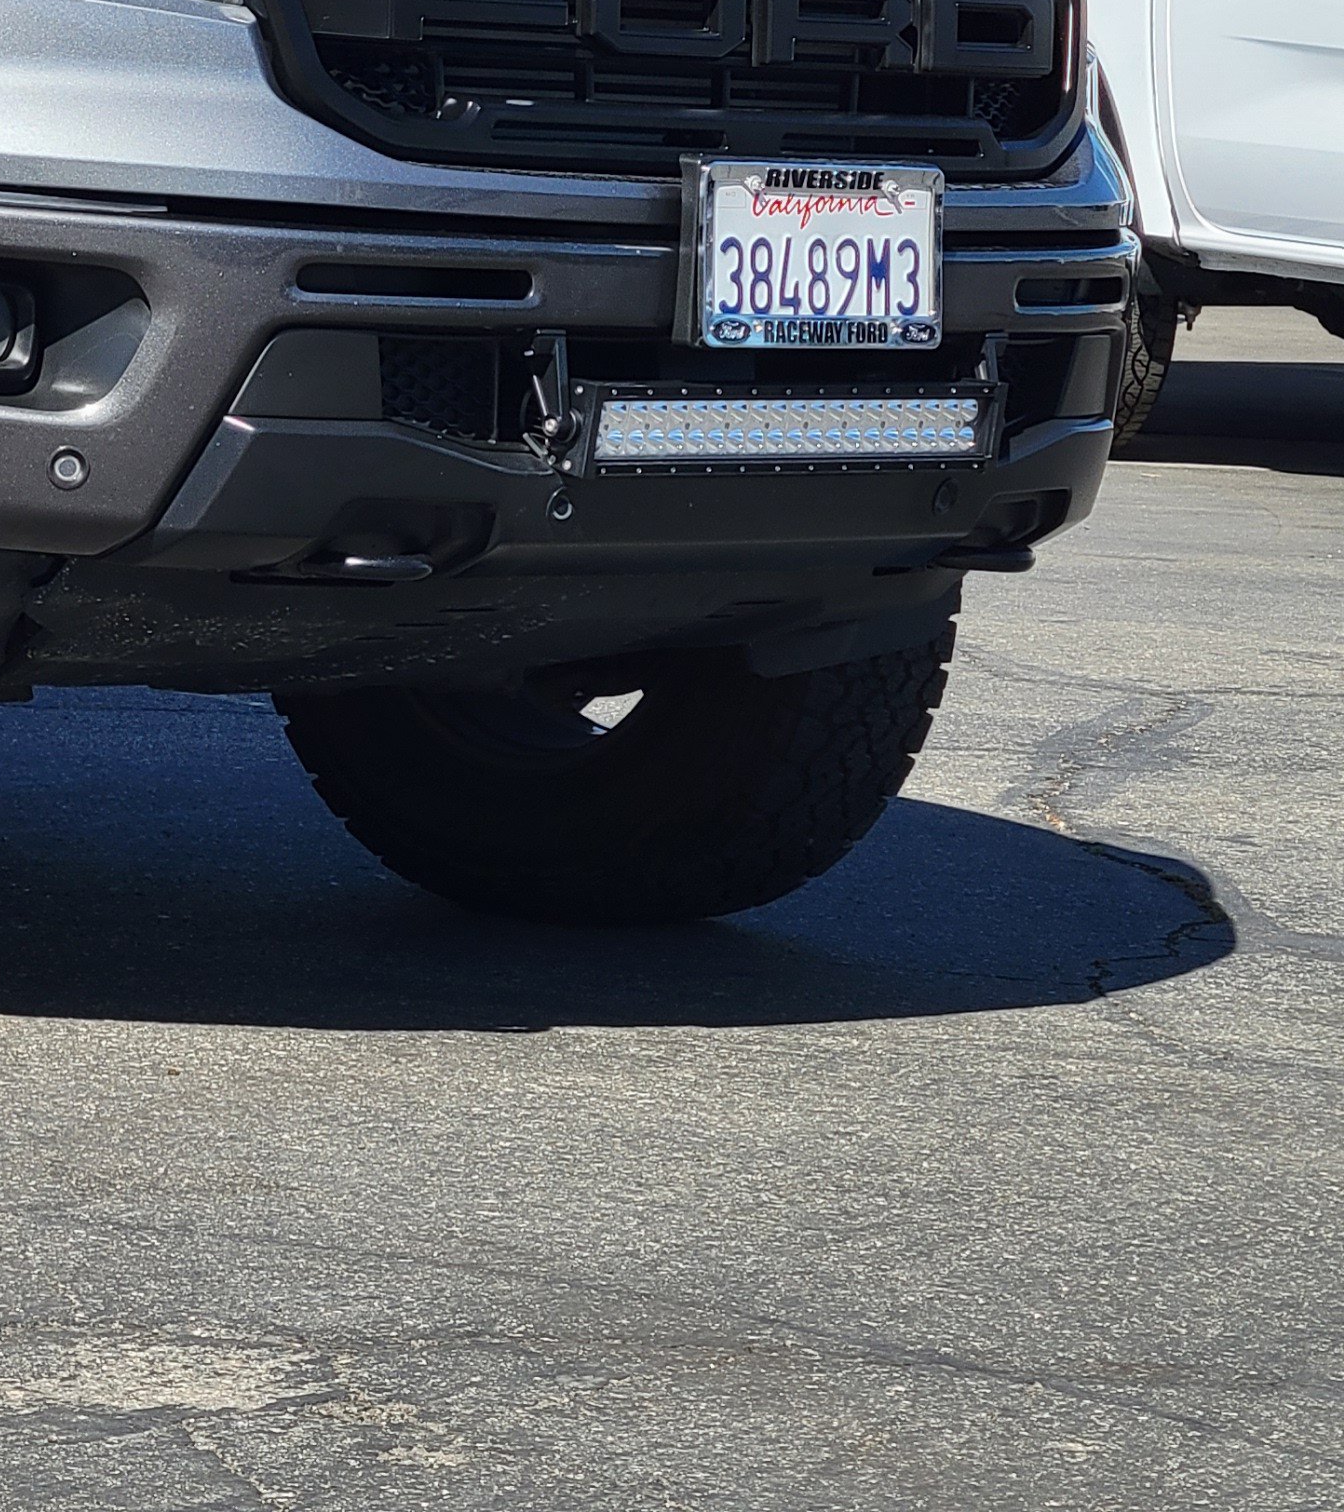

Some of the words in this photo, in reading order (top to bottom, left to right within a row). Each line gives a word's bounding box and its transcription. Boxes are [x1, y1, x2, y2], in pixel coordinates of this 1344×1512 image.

[764, 168, 885, 190] RIVERSIDE
[751, 186, 894, 230] California
[718, 236, 920, 317] 38489M3
[763, 320, 845, 345] RACEWAY
[846, 322, 889, 345] FORD
